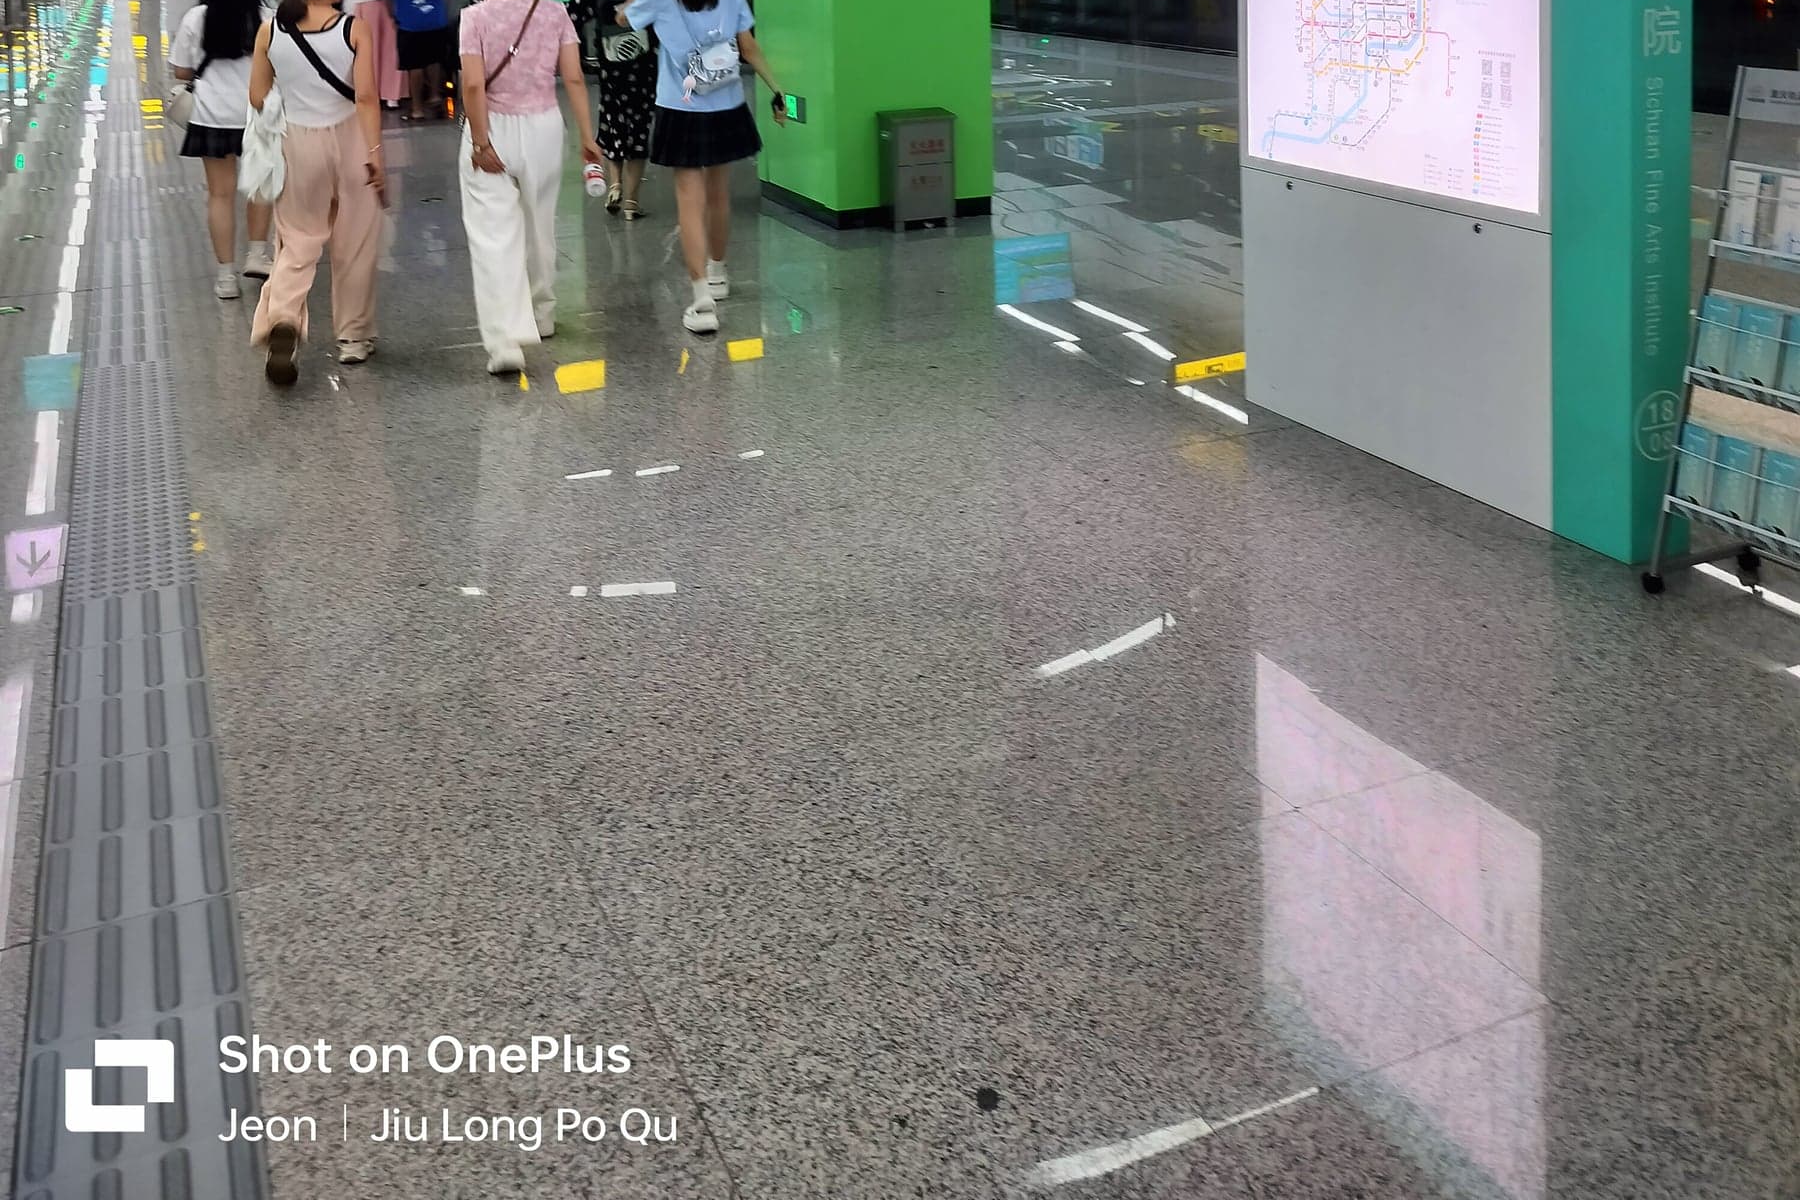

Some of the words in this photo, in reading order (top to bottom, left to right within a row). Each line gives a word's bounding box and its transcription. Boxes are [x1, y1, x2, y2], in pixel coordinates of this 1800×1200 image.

[1646, 76, 1664, 160] Sichuan
[1646, 169, 1664, 214] Fine
[1646, 223, 1663, 264] Arts
[1645, 274, 1663, 357] Institute
[1647, 399, 1674, 425] 18
